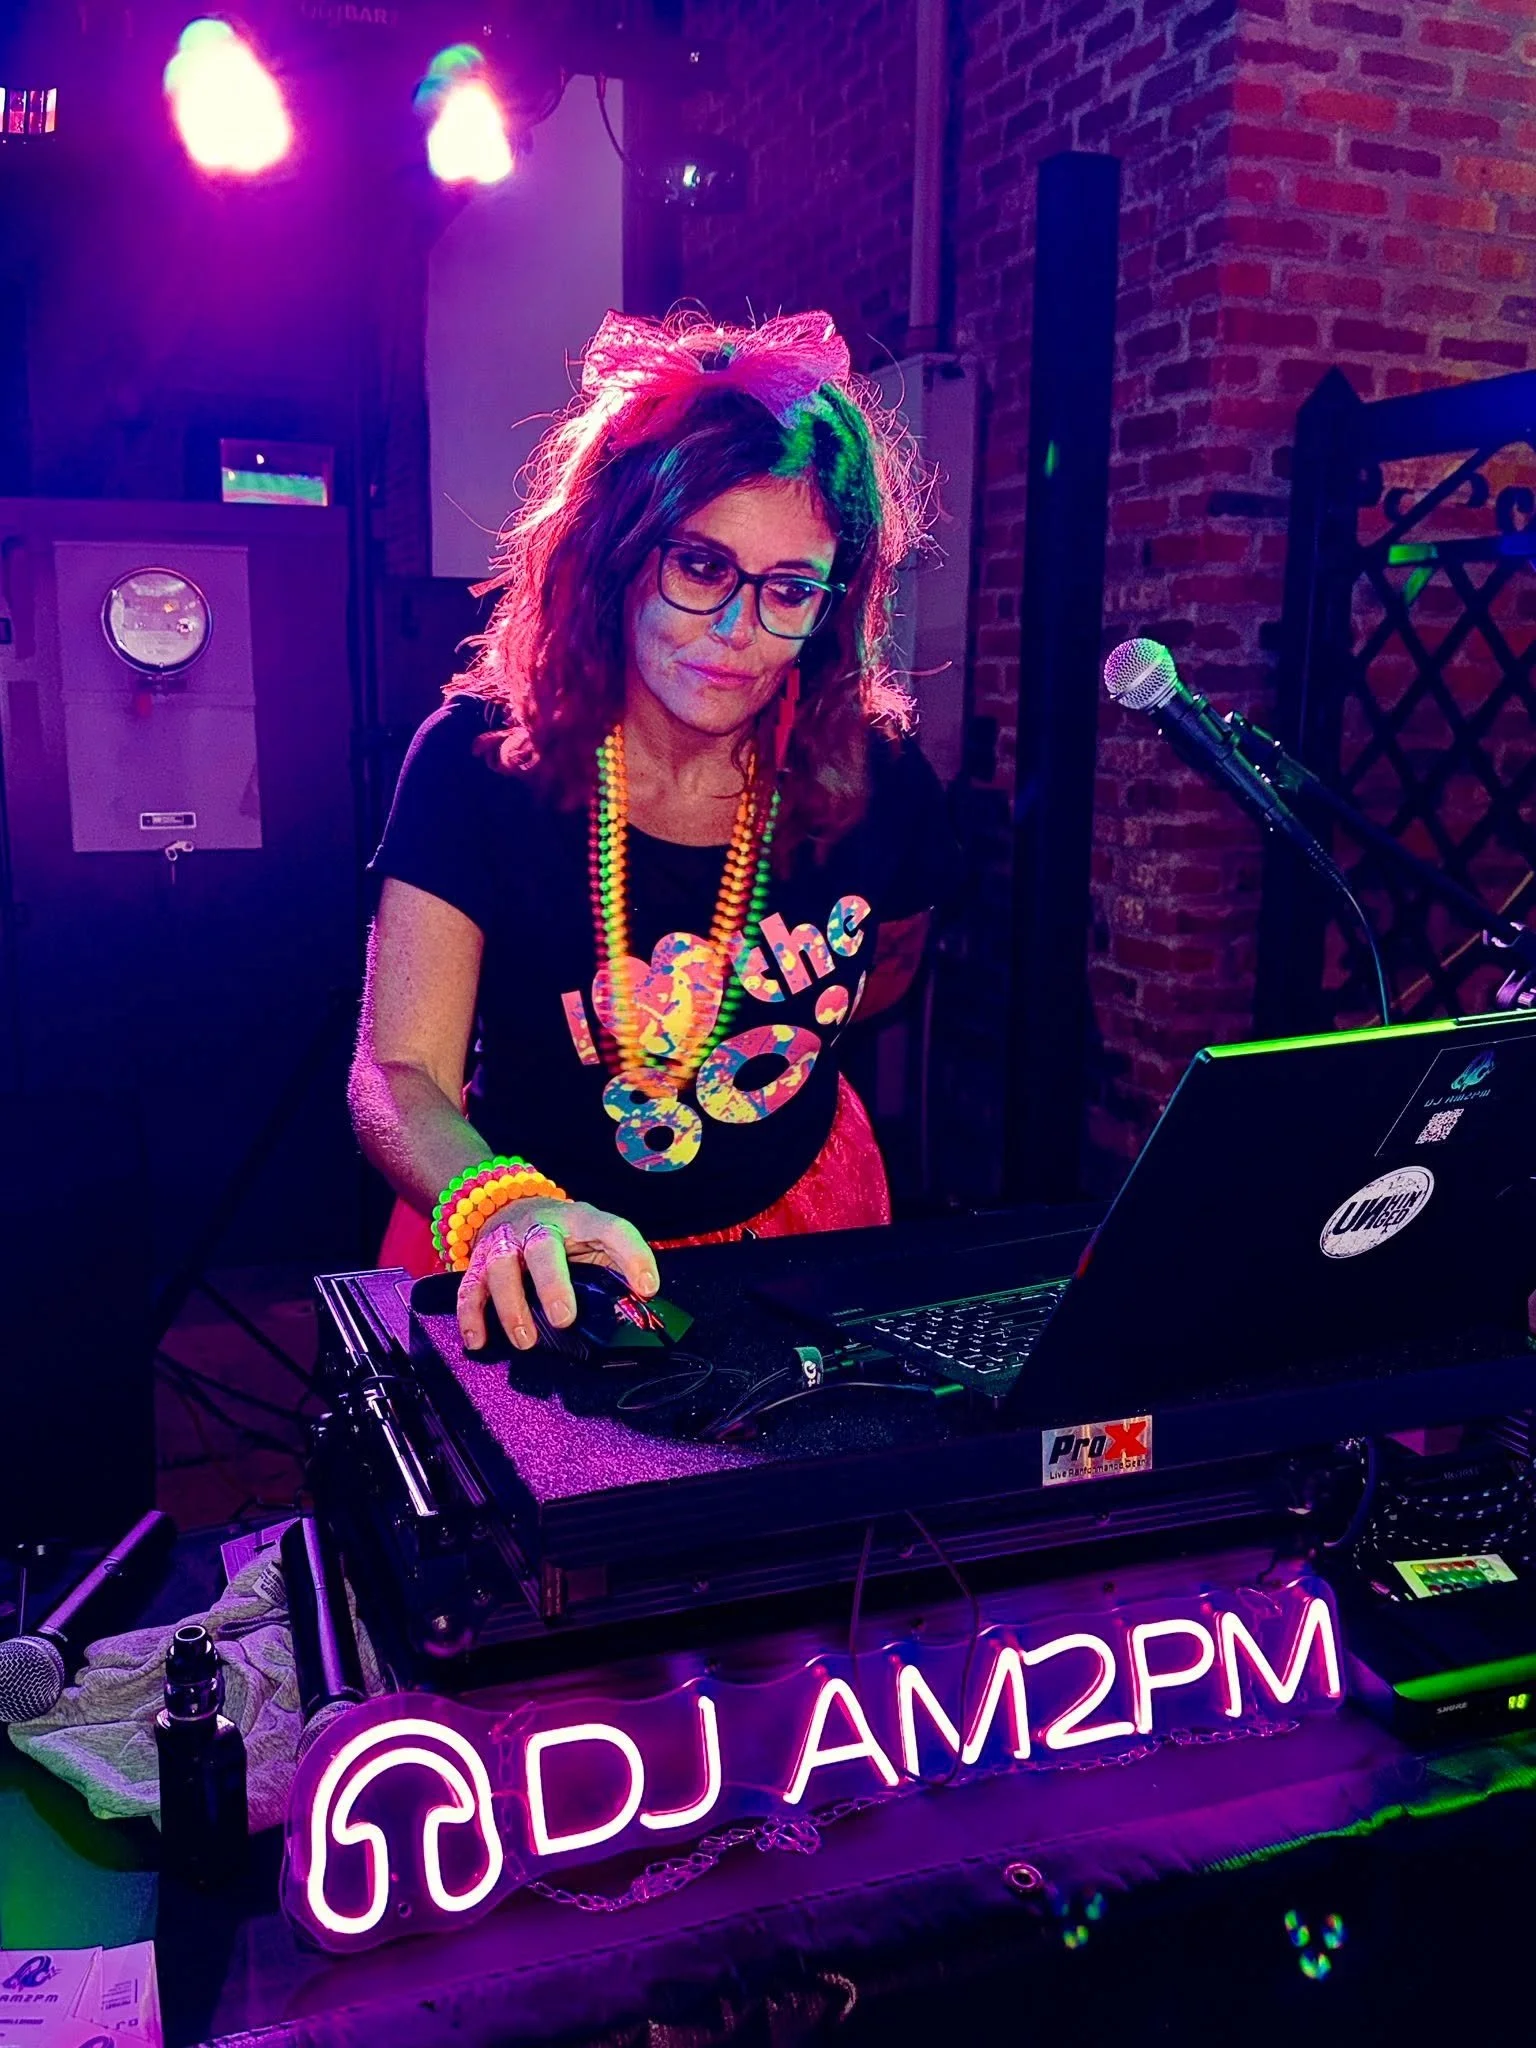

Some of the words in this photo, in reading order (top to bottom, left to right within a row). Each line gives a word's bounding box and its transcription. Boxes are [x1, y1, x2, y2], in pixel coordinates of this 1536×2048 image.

[561, 990, 600, 1065] I
[727, 895, 871, 1002] the
[1049, 1421, 1148, 1465] ProX
[1049, 1470, 1067, 1480] Live
[524, 1695, 722, 1856] DJ
[784, 1597, 1342, 1805] AM2PM
[0, 1994, 59, 2003] AM2PM
